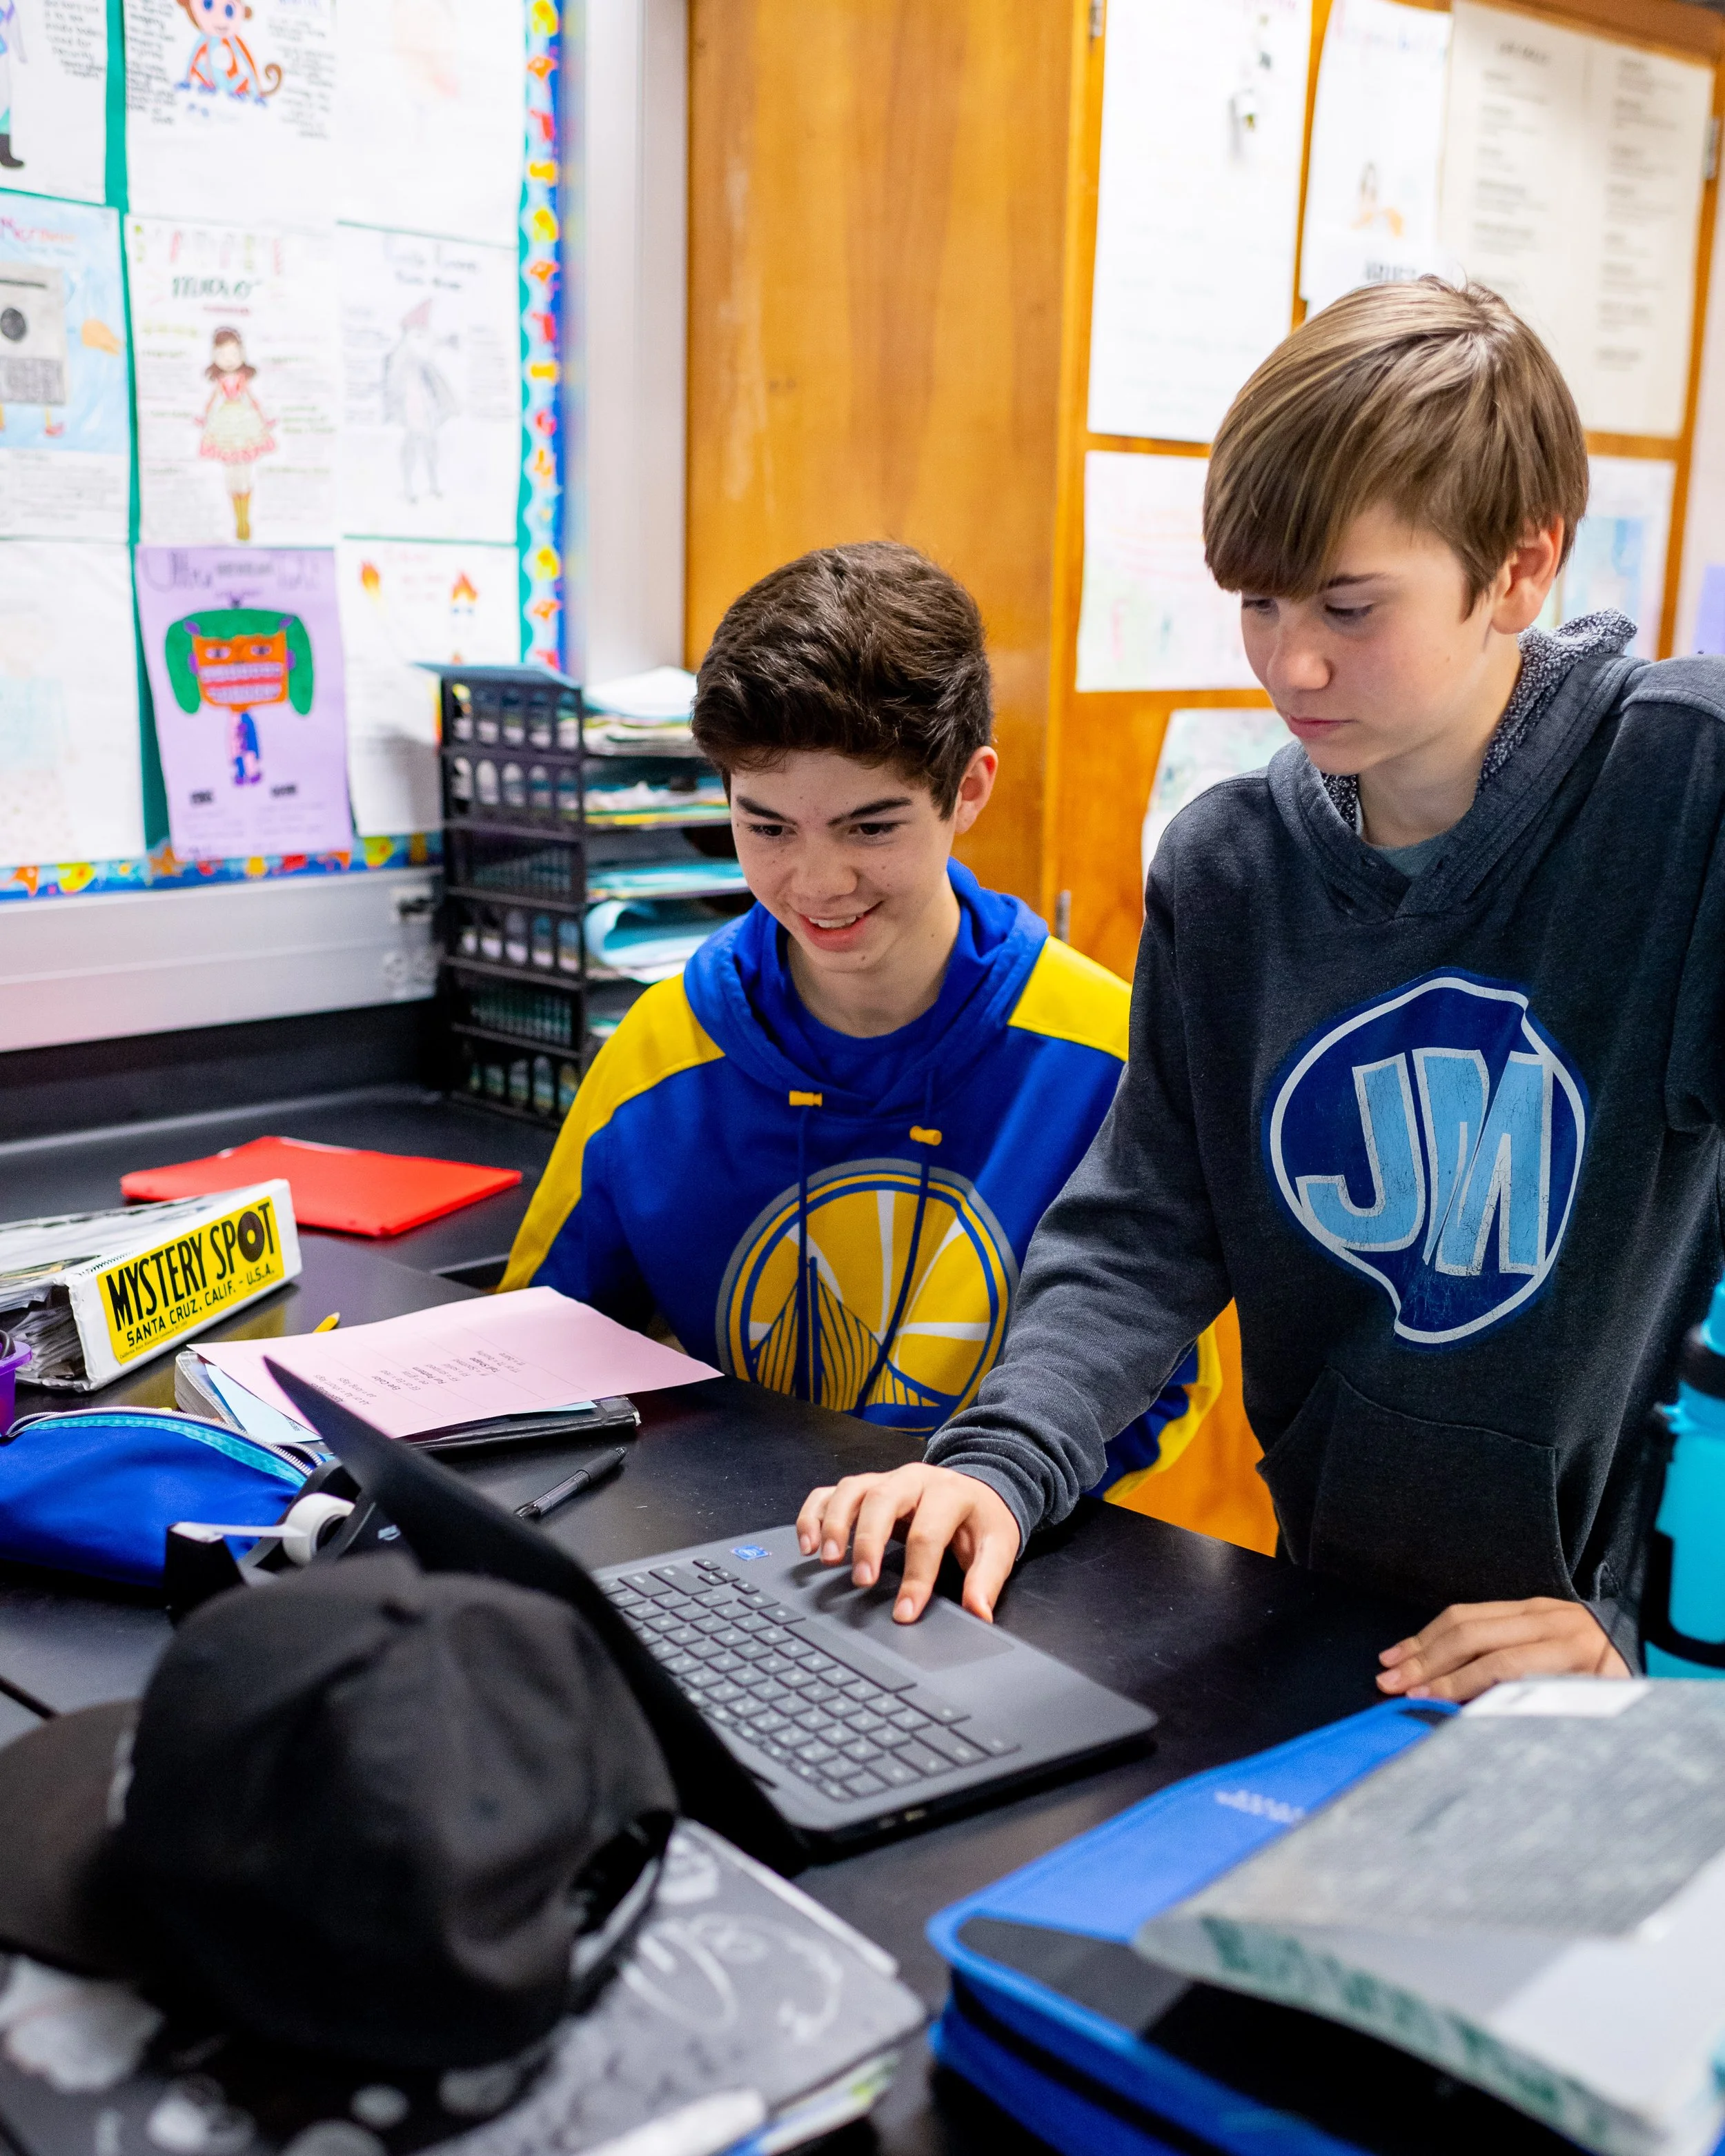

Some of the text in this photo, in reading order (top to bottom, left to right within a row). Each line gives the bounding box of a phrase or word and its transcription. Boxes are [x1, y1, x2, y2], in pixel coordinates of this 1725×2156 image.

[106, 1202, 275, 1332] MYSTERY SPOT
[126, 1315, 166, 1347] SANTA
[204, 1280, 236, 1307] CALIF.
[246, 1263, 275, 1285] U.S.A.
